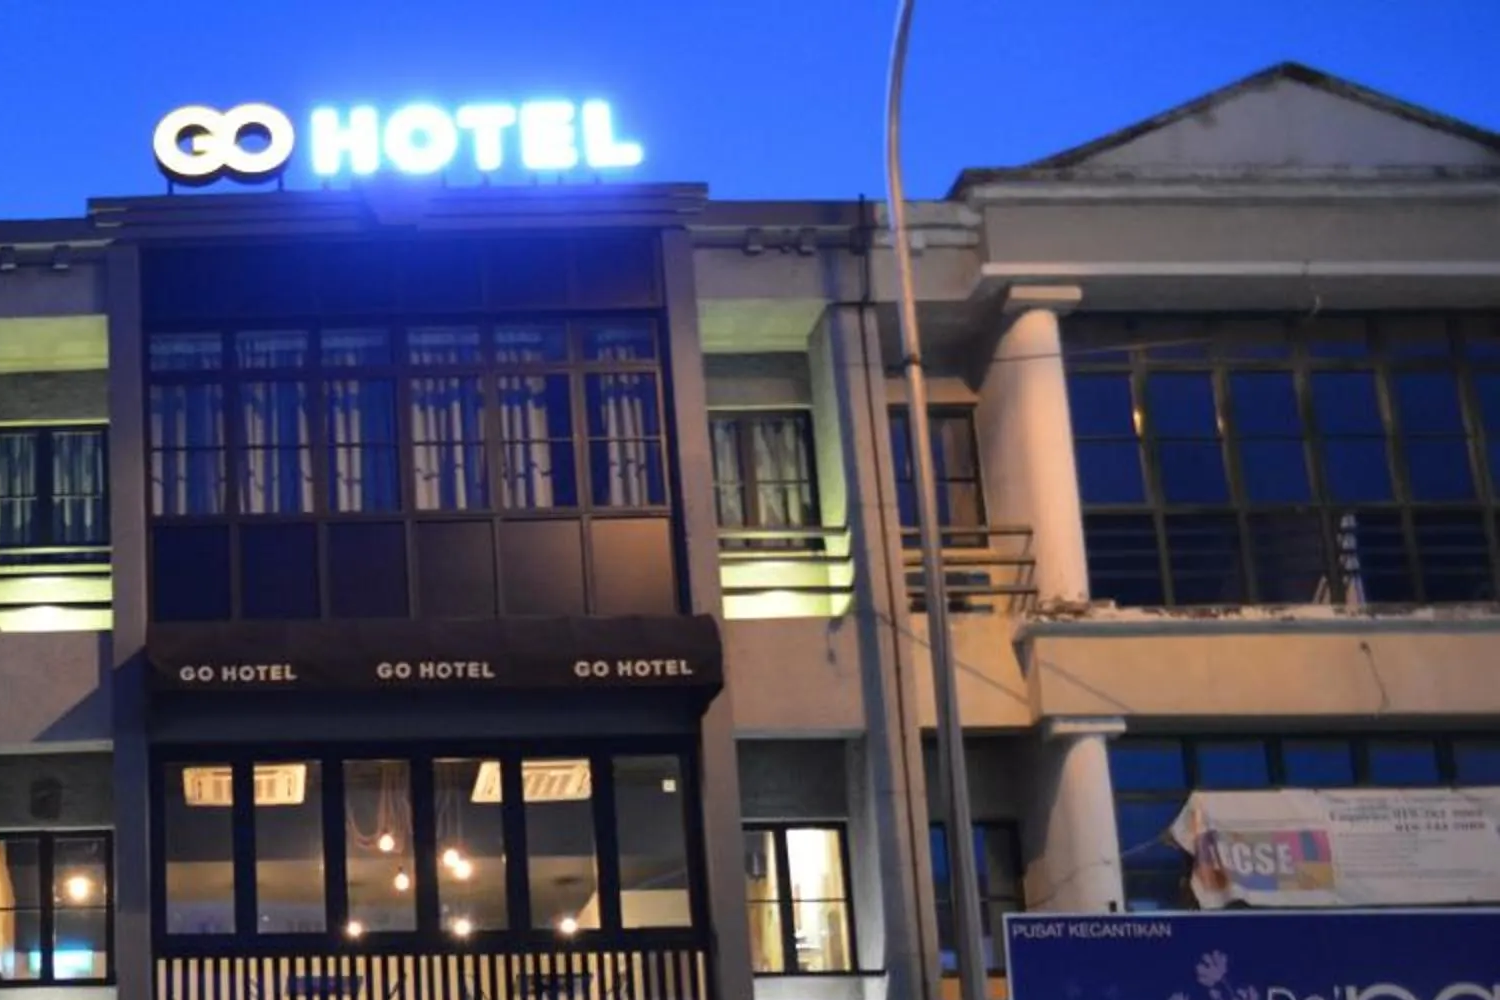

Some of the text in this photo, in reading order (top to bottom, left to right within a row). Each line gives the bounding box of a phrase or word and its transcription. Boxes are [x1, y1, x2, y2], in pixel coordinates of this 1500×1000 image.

[152, 98, 643, 180] GO HOTEL
[179, 664, 297, 682] GO HOTEL
[376, 662, 496, 680] GO HOTEL
[574, 659, 693, 677] GO HOTEL
[1012, 922, 1172, 938] PUSAT KECANTIKAN
